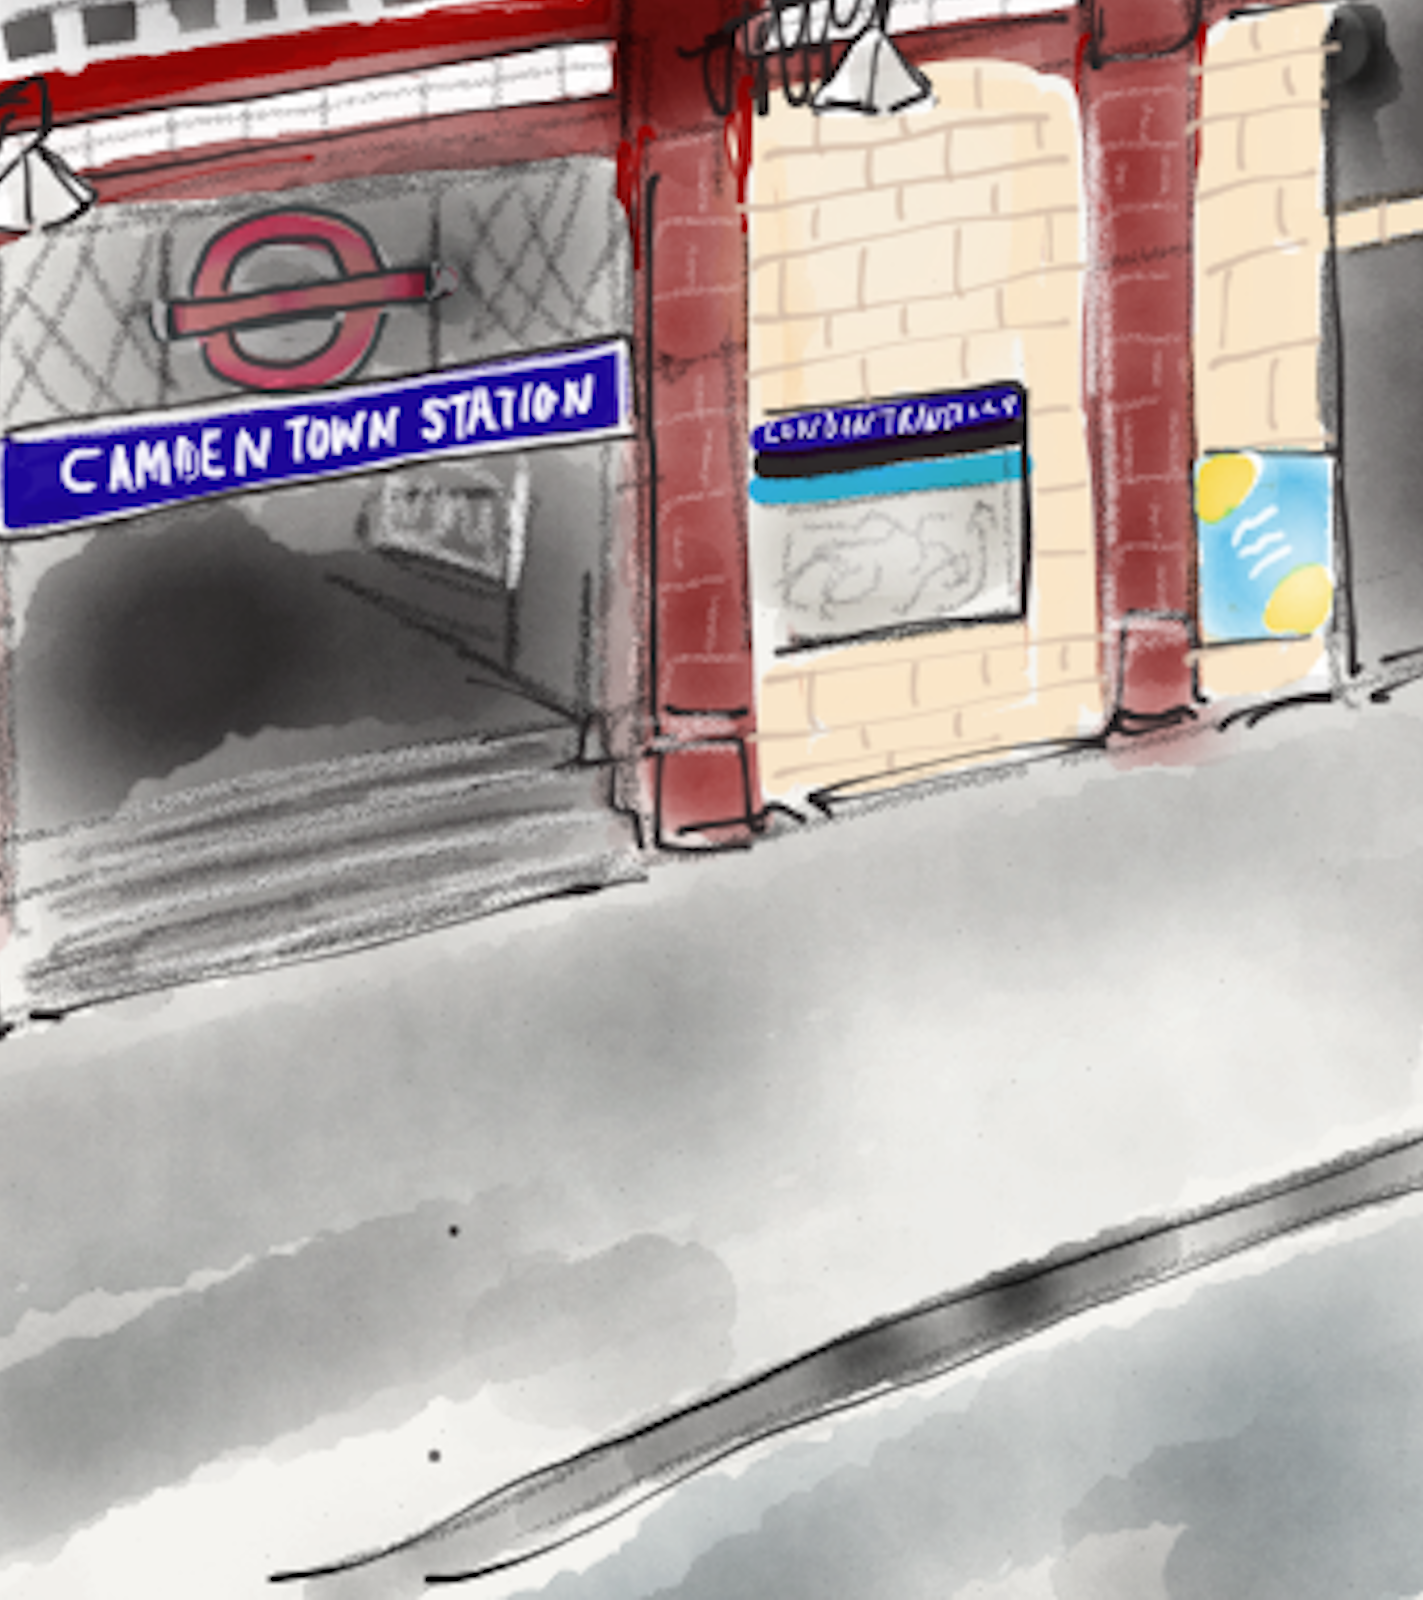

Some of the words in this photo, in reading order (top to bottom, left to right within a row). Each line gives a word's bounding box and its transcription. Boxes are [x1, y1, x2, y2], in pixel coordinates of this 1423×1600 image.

[59, 426, 273, 494] CAMDEN
[285, 406, 402, 464] TOWN
[420, 372, 595, 443] STATION
